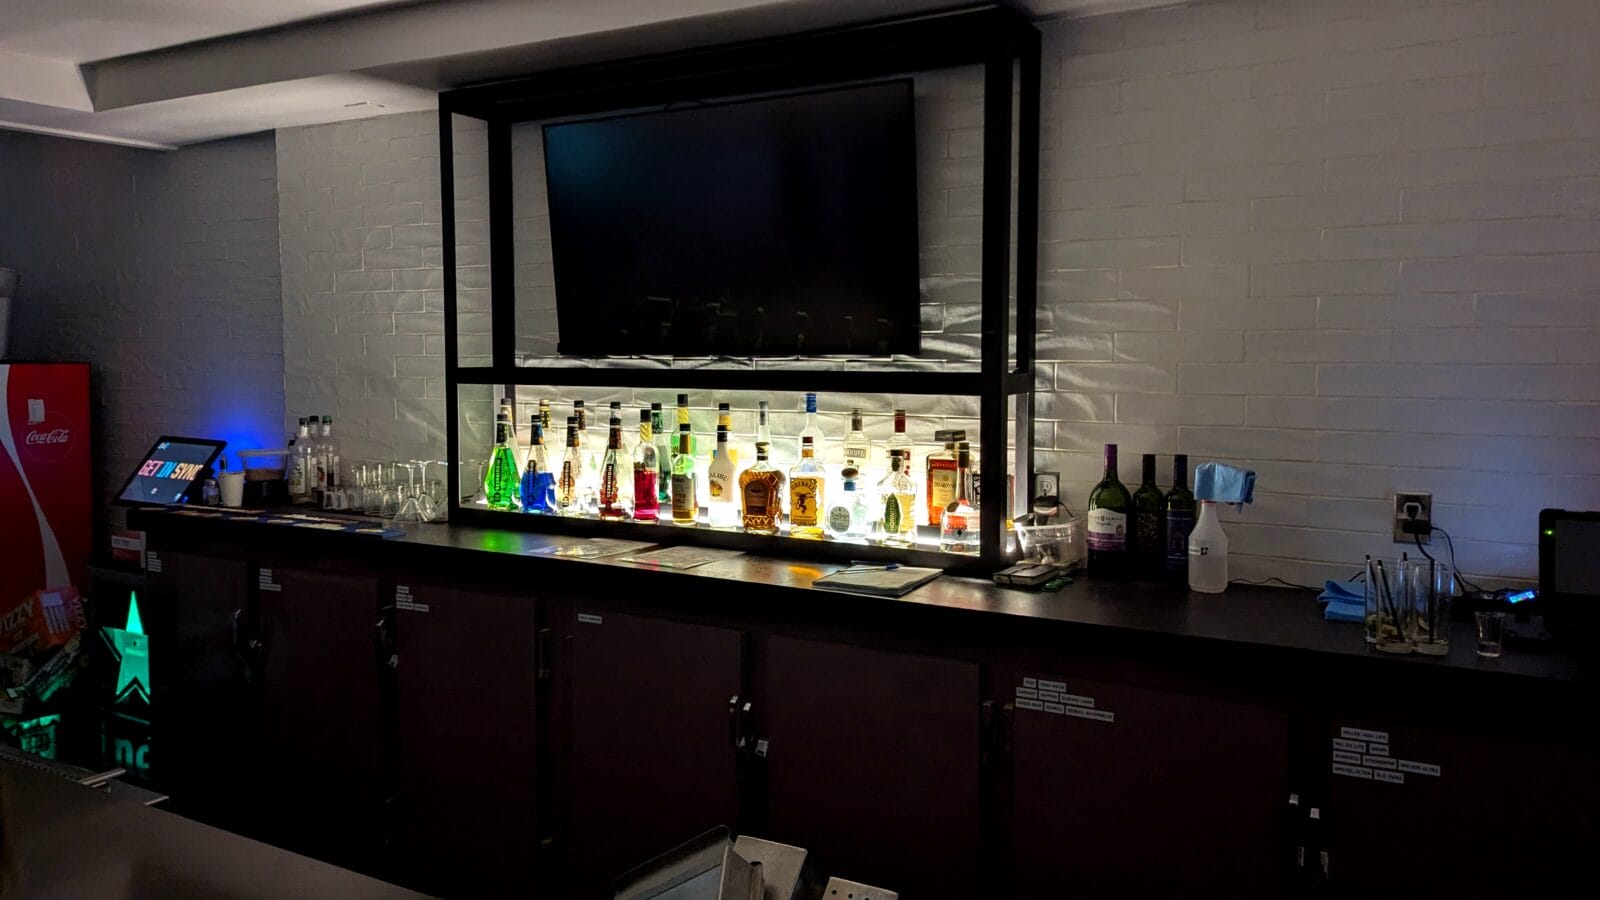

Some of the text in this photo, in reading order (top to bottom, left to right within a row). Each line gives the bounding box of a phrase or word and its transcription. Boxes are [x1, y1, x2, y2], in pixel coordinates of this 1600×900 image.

[138, 460, 205, 481] GET IN SYNC
